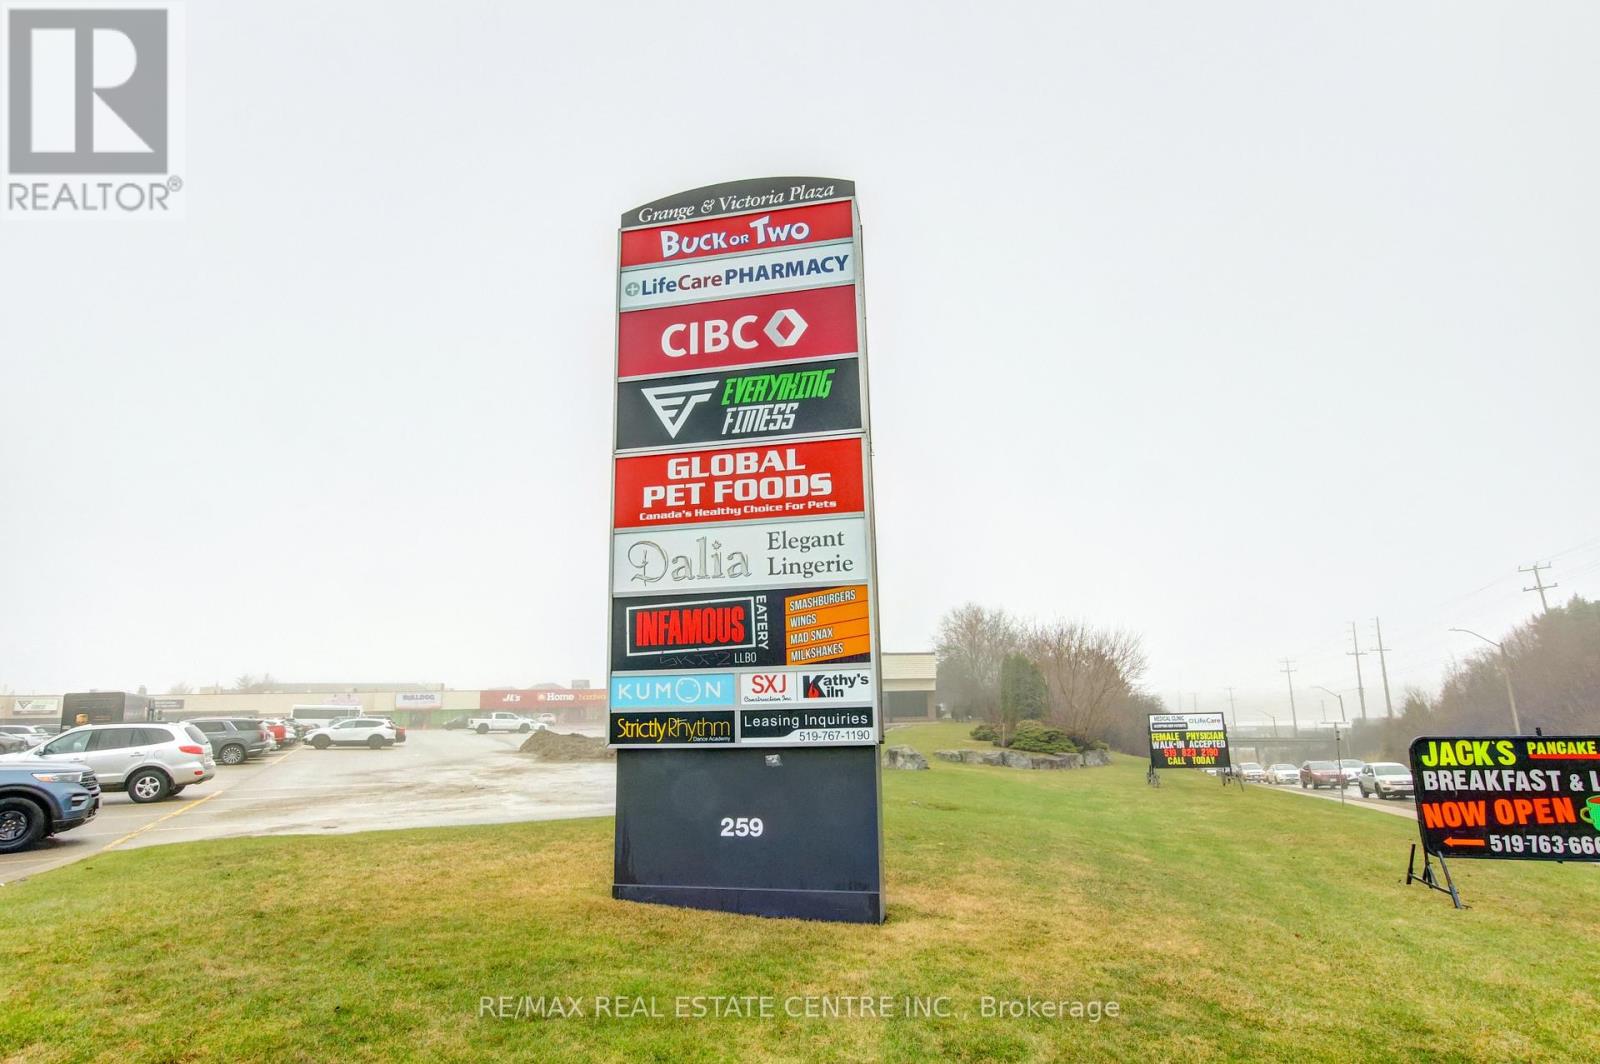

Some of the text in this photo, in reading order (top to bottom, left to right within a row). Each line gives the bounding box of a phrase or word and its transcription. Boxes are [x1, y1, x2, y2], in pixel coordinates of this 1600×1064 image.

[638, 184, 835, 223] Grange & Victoria Plaza
[661, 314, 759, 358] CIBC
[721, 402, 799, 435] FITNESS
[667, 448, 806, 480] GLOBAL
[643, 472, 832, 508] PET FOODS
[639, 499, 837, 521] Canada's Healthy Choice For Pets
[767, 530, 845, 553] Elegant
[627, 536, 752, 586] Dalia
[767, 554, 854, 579] Lingerie
[789, 589, 856, 612] SMASHBURGERS
[635, 606, 745, 647] INFAMOUS
[756, 595, 769, 650] EATERY
[790, 614, 817, 628] WINGS
[790, 627, 833, 645] MAD SNAX
[734, 652, 757, 664] LLBO
[791, 642, 844, 662] MILKSHAKES
[618, 677, 721, 703] KUMON
[751, 674, 787, 694] SXJ
[802, 673, 869, 699] Kathy's
[546, 692, 575, 702] Home
[617, 717, 666, 743] Strictly
[744, 713, 868, 729] Leasing Inquiries
[799, 730, 870, 742] 519-767-1190
[1151, 731, 1224, 741] FEMALE PHYSICIAN
[1152, 740, 1226, 749] WALK-IN ACCEPTED
[1164, 749, 1177, 757] 519
[1168, 756, 1216, 765] CALL TODAY
[1421, 740, 1598, 767] JACK'S PANCAKE
[1423, 769, 1561, 792] BREAKFAST
[1569, 773, 1585, 792] &
[1422, 797, 1577, 829] NOW OPEN
[720, 817, 764, 837] 259
